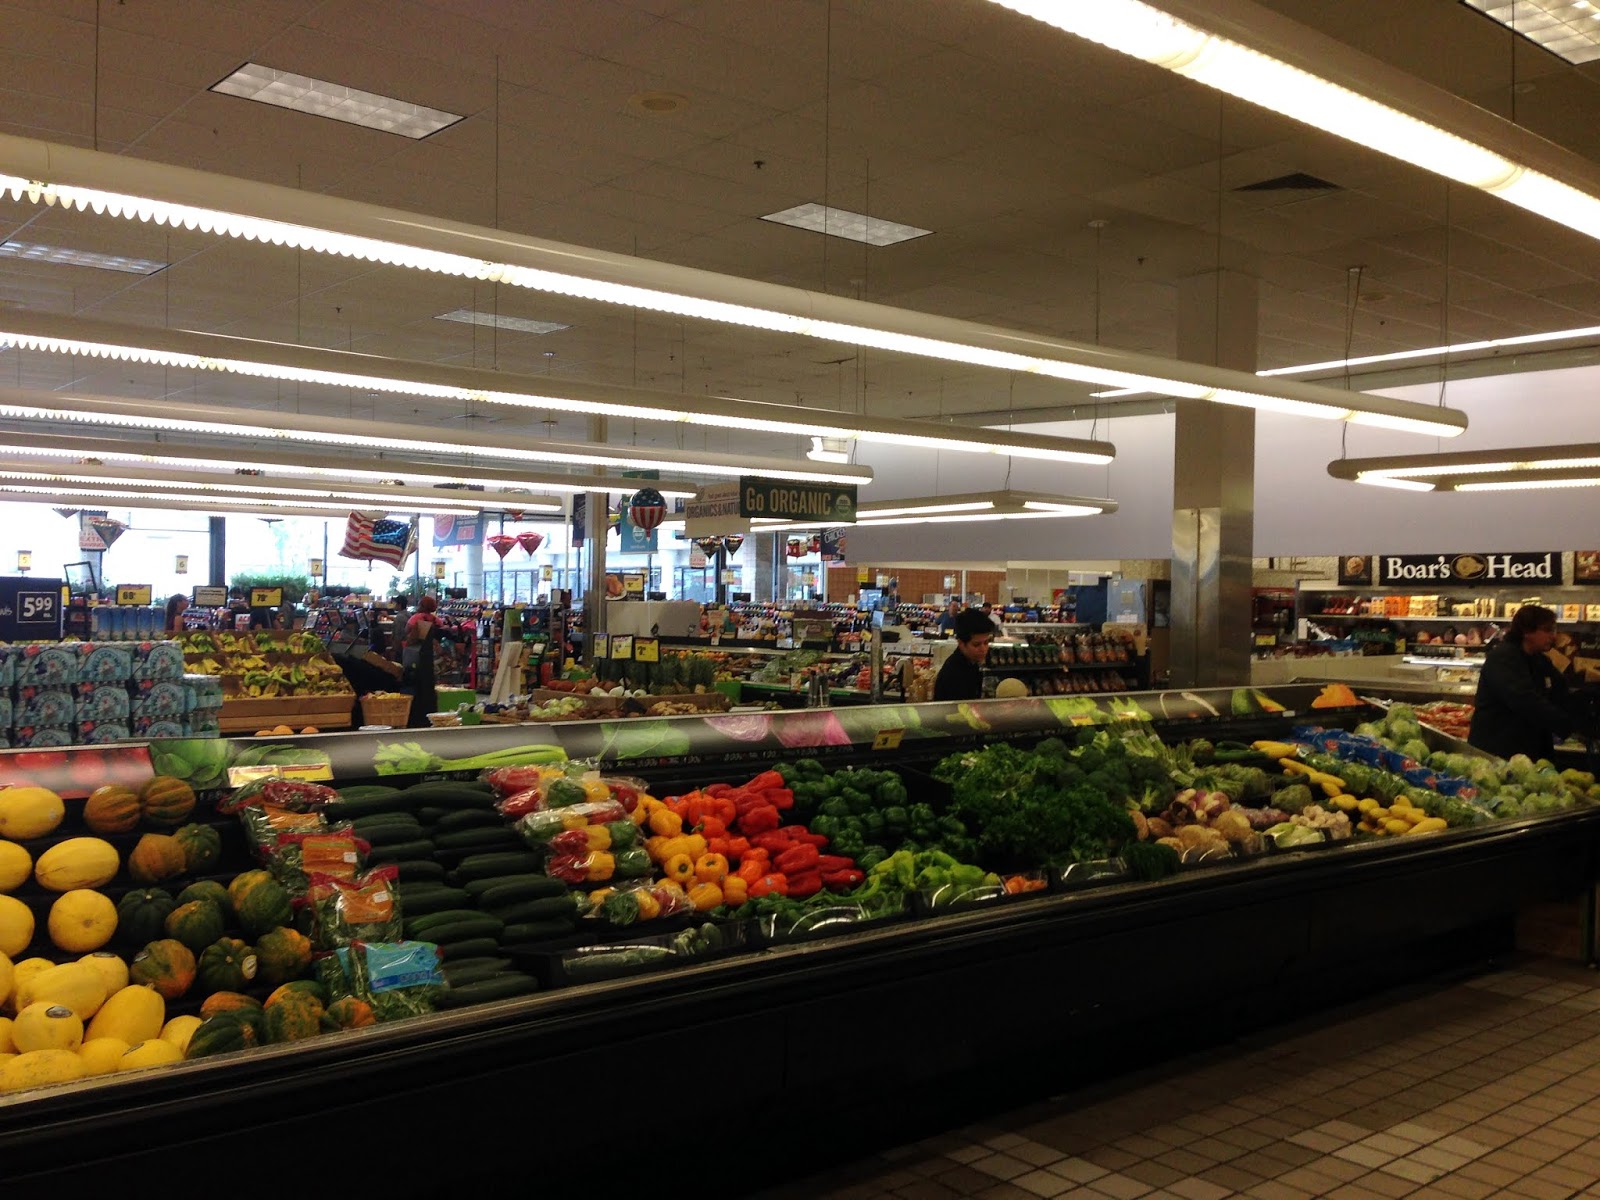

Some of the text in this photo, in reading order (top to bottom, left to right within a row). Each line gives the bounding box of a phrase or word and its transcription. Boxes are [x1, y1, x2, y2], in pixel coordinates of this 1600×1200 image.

[746, 487, 764, 512] Go
[770, 488, 831, 516] ORGANIC
[1386, 554, 1553, 580] Boar's Head
